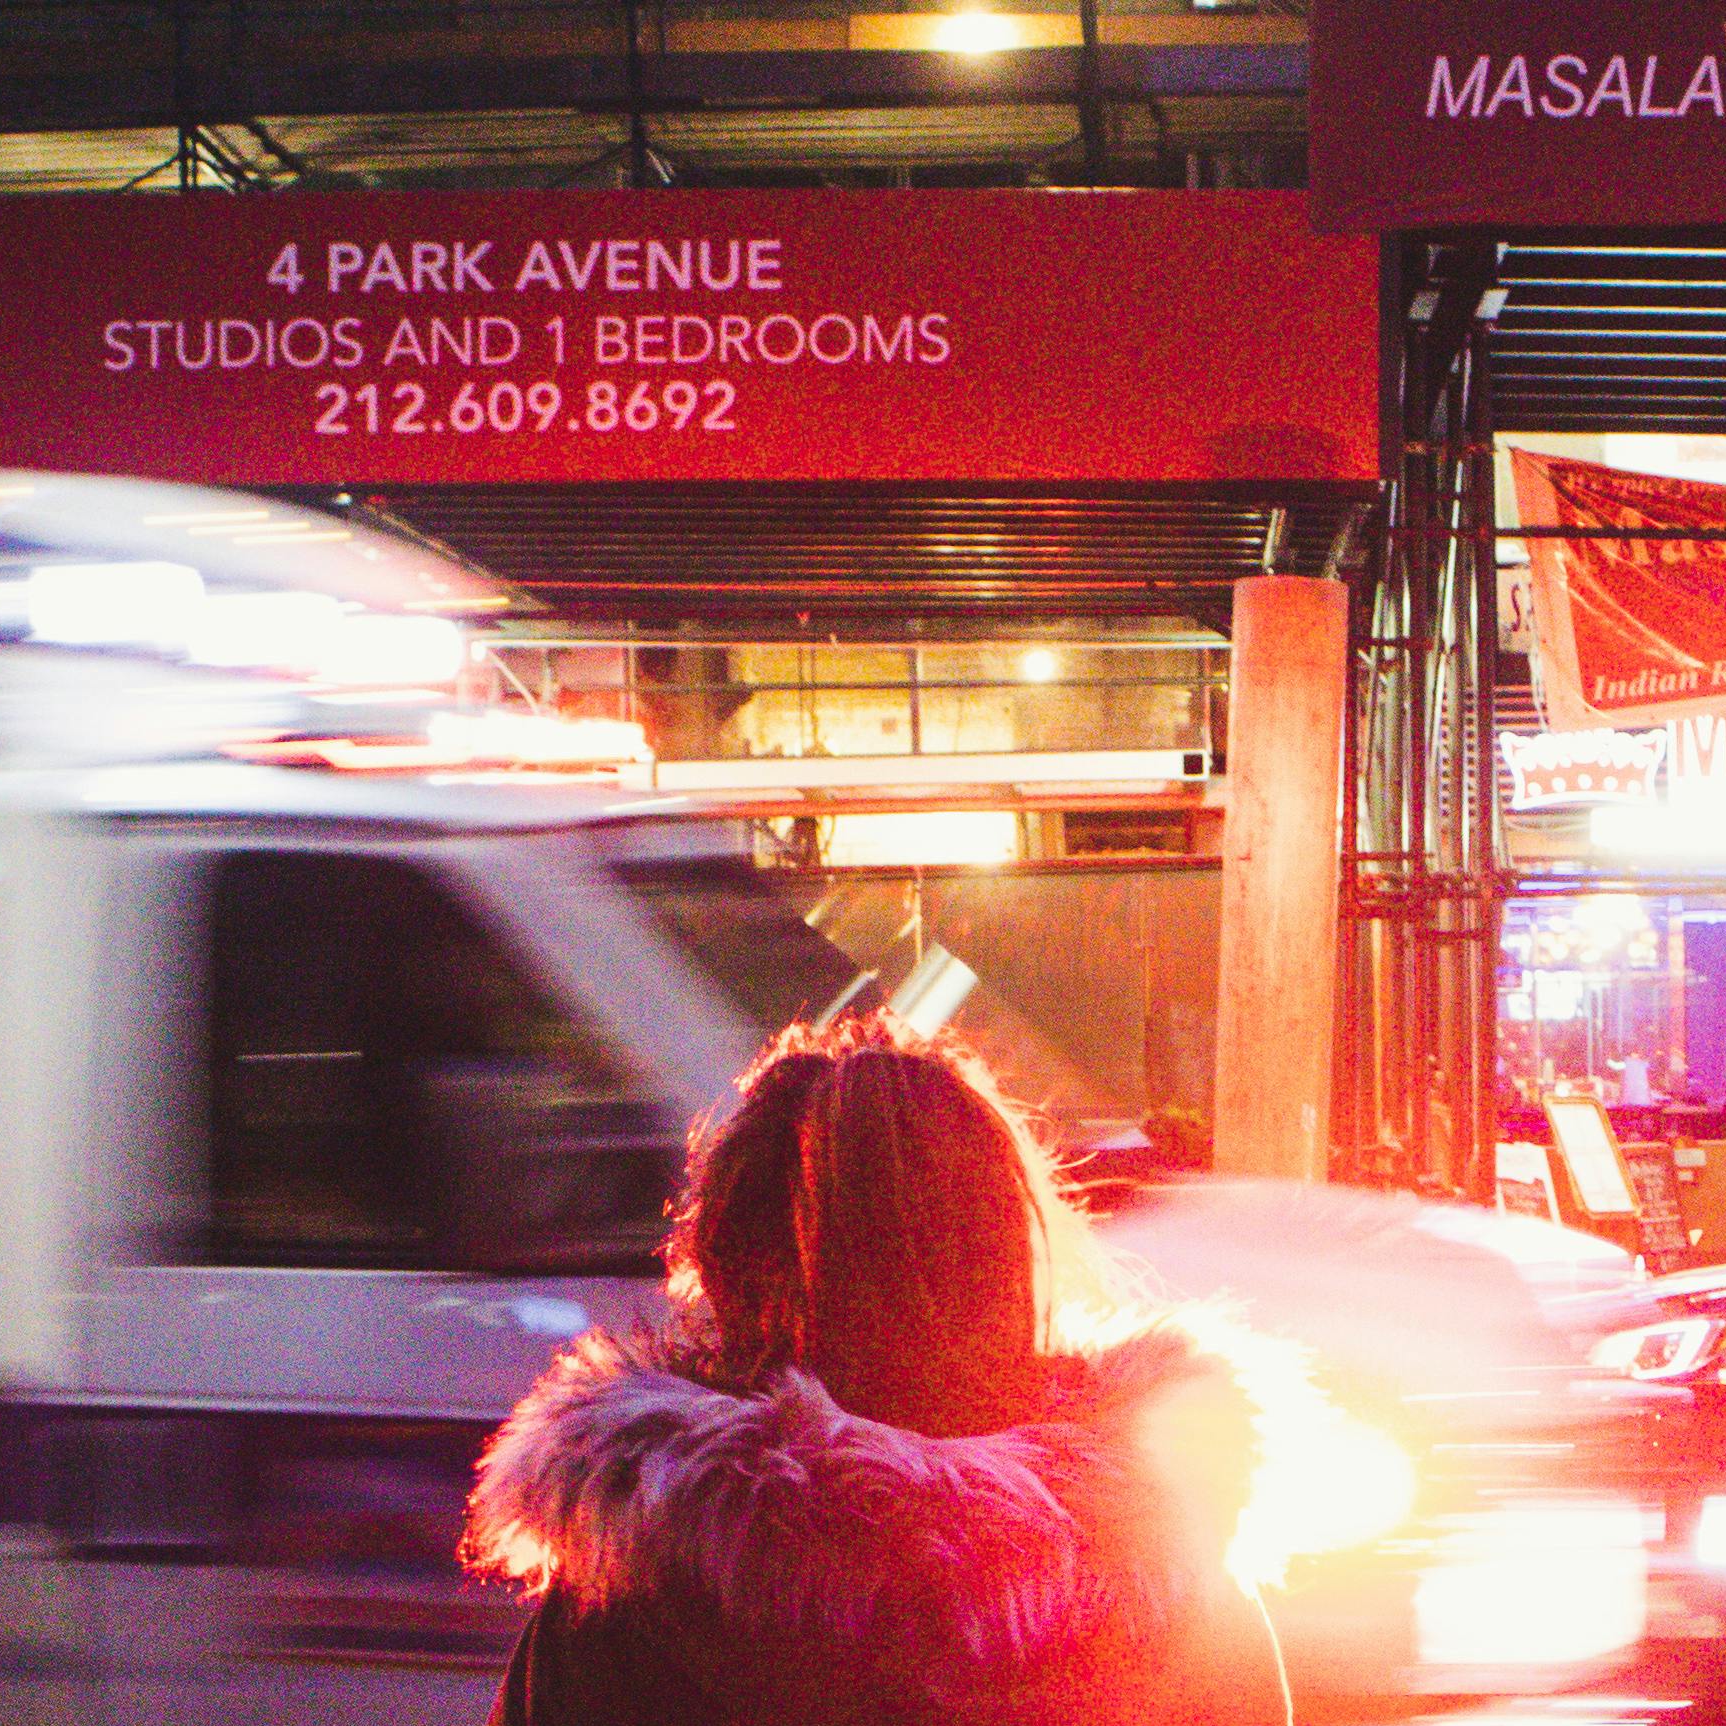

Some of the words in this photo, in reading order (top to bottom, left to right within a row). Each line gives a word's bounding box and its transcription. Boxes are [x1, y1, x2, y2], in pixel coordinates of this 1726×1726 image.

[1427, 54, 1725, 119] MASALA
[265, 241, 305, 294] 4
[326, 240, 495, 293] PARK
[513, 239, 784, 292] AVENUE
[103, 318, 363, 370] STUDIOS
[383, 316, 521, 368] AND
[545, 316, 566, 366] 1
[596, 312, 952, 366] BEDROOMS
[313, 379, 737, 436] 212.609.8692
[1593, 668, 1700, 702] Indian
